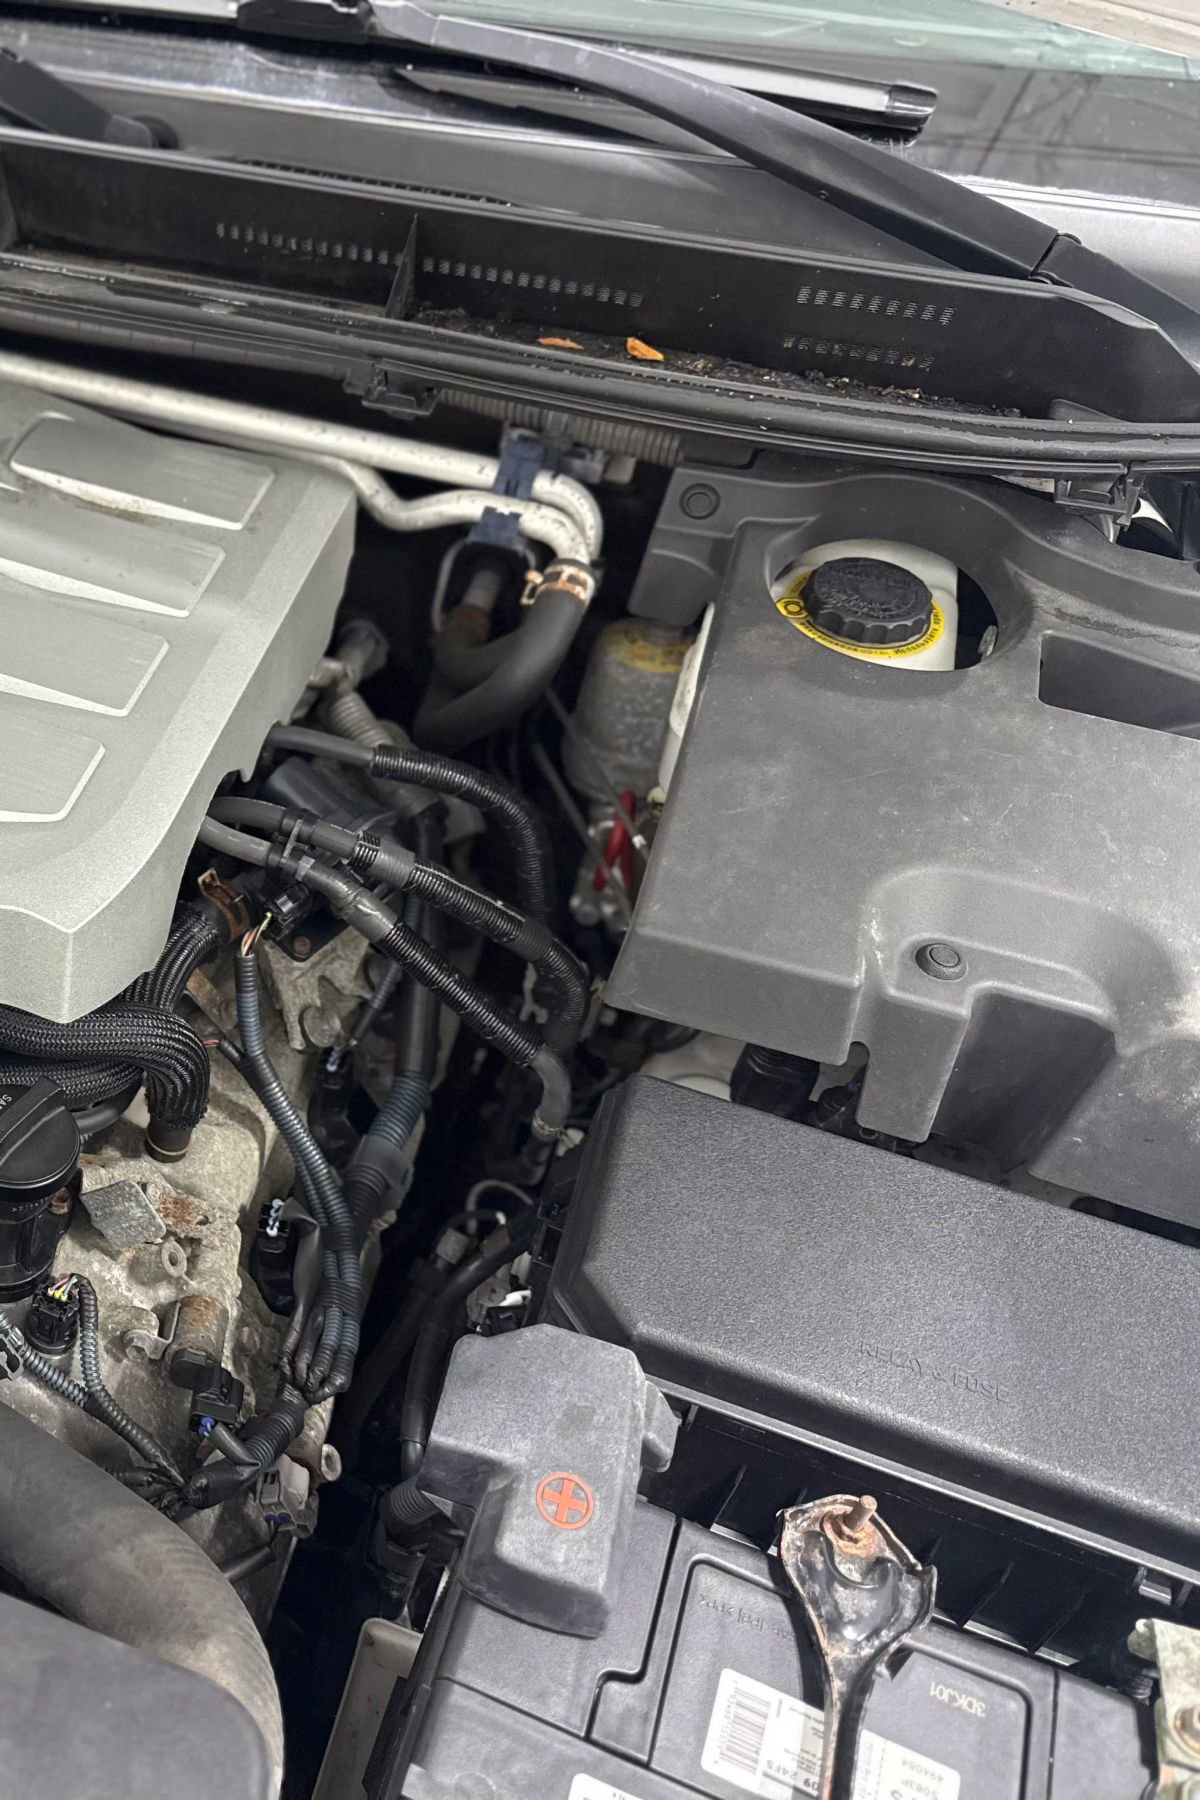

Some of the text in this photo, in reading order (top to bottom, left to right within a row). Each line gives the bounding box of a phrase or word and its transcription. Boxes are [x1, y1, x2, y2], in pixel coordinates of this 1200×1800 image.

[860, 1340, 923, 1377] RELAY
[952, 1366, 1010, 1404] FUSE
[930, 1681, 987, 1717] 3DKJ01
